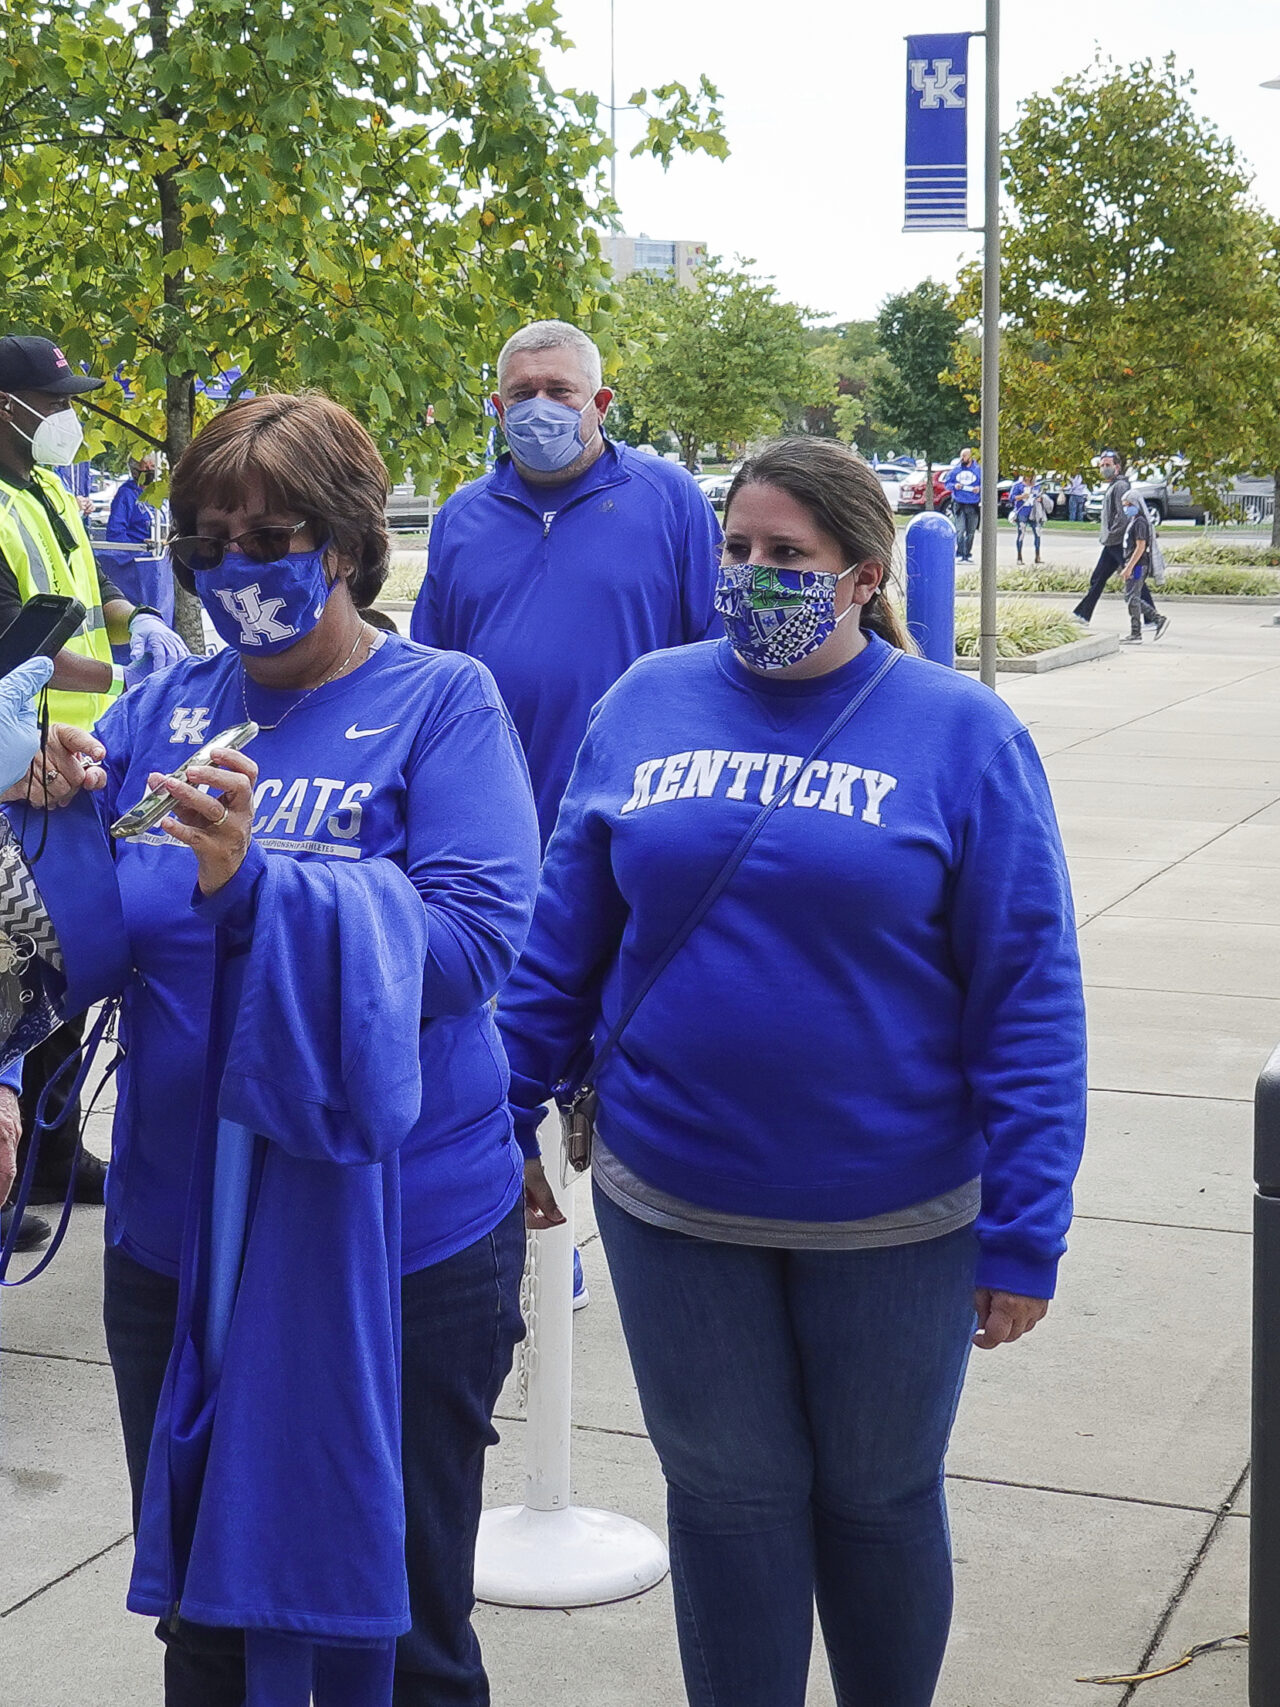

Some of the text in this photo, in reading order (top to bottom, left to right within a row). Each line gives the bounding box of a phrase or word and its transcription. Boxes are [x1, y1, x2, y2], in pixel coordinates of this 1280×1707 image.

[908, 59, 966, 109] UK
[211, 582, 297, 646] UK
[169, 707, 212, 744] UK
[619, 749, 898, 828] KENTUCKY
